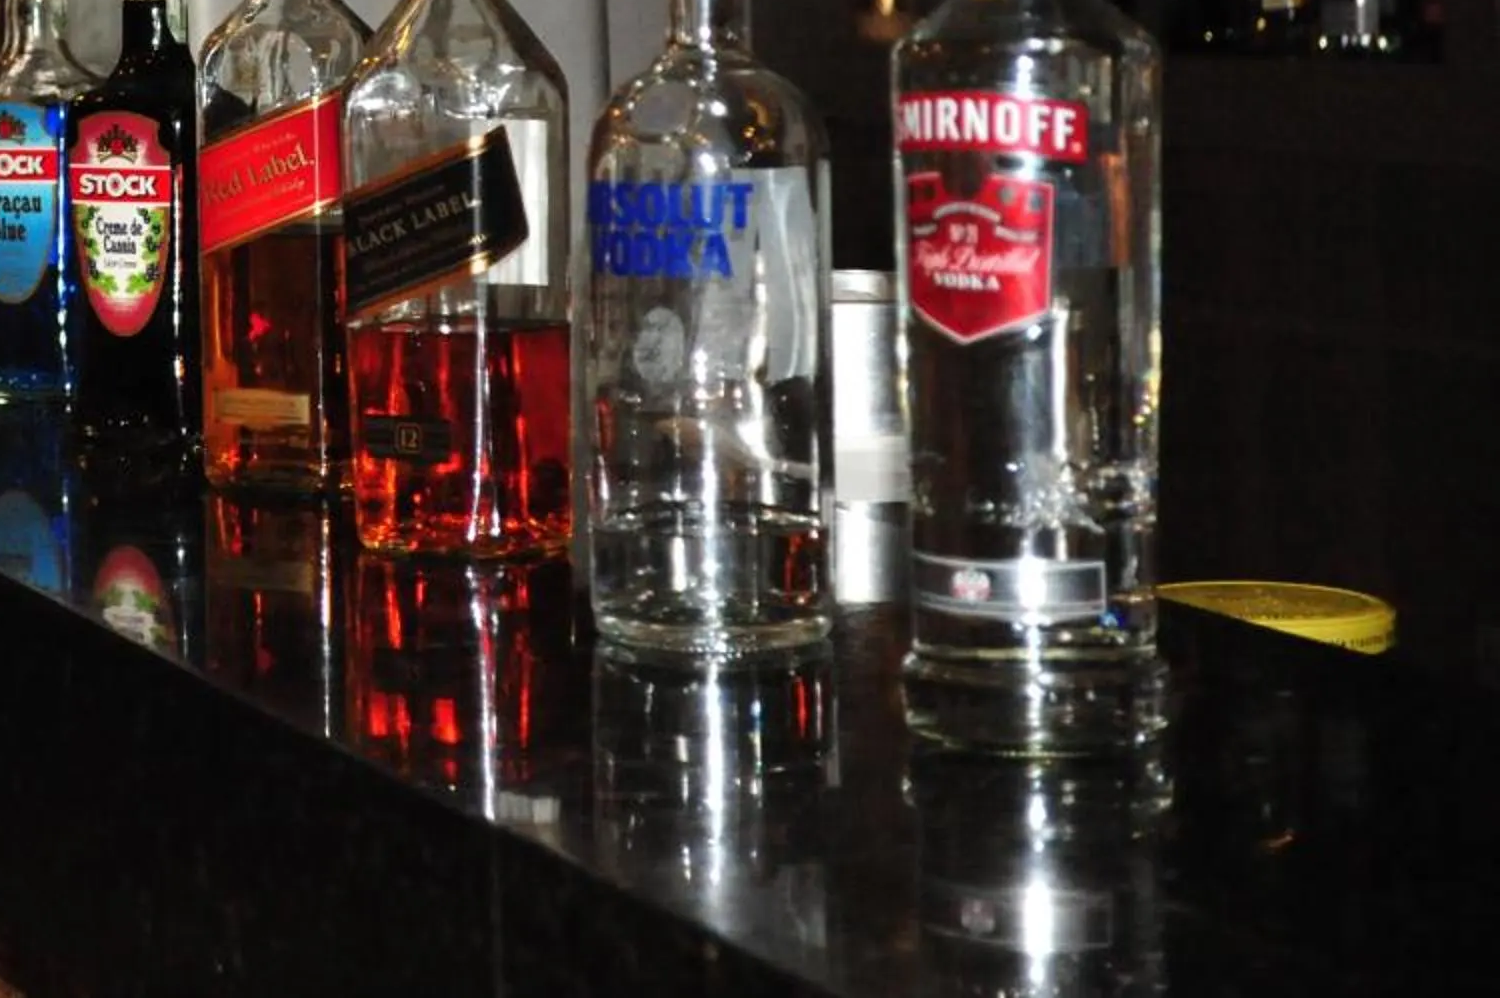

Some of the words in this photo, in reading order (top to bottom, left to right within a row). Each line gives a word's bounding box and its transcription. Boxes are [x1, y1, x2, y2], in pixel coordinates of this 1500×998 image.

[901, 96, 1077, 150] MIRNOFF
[79, 171, 157, 198] STOCK
[588, 182, 754, 230] BSOLUT
[932, 272, 1001, 291] VODKA
